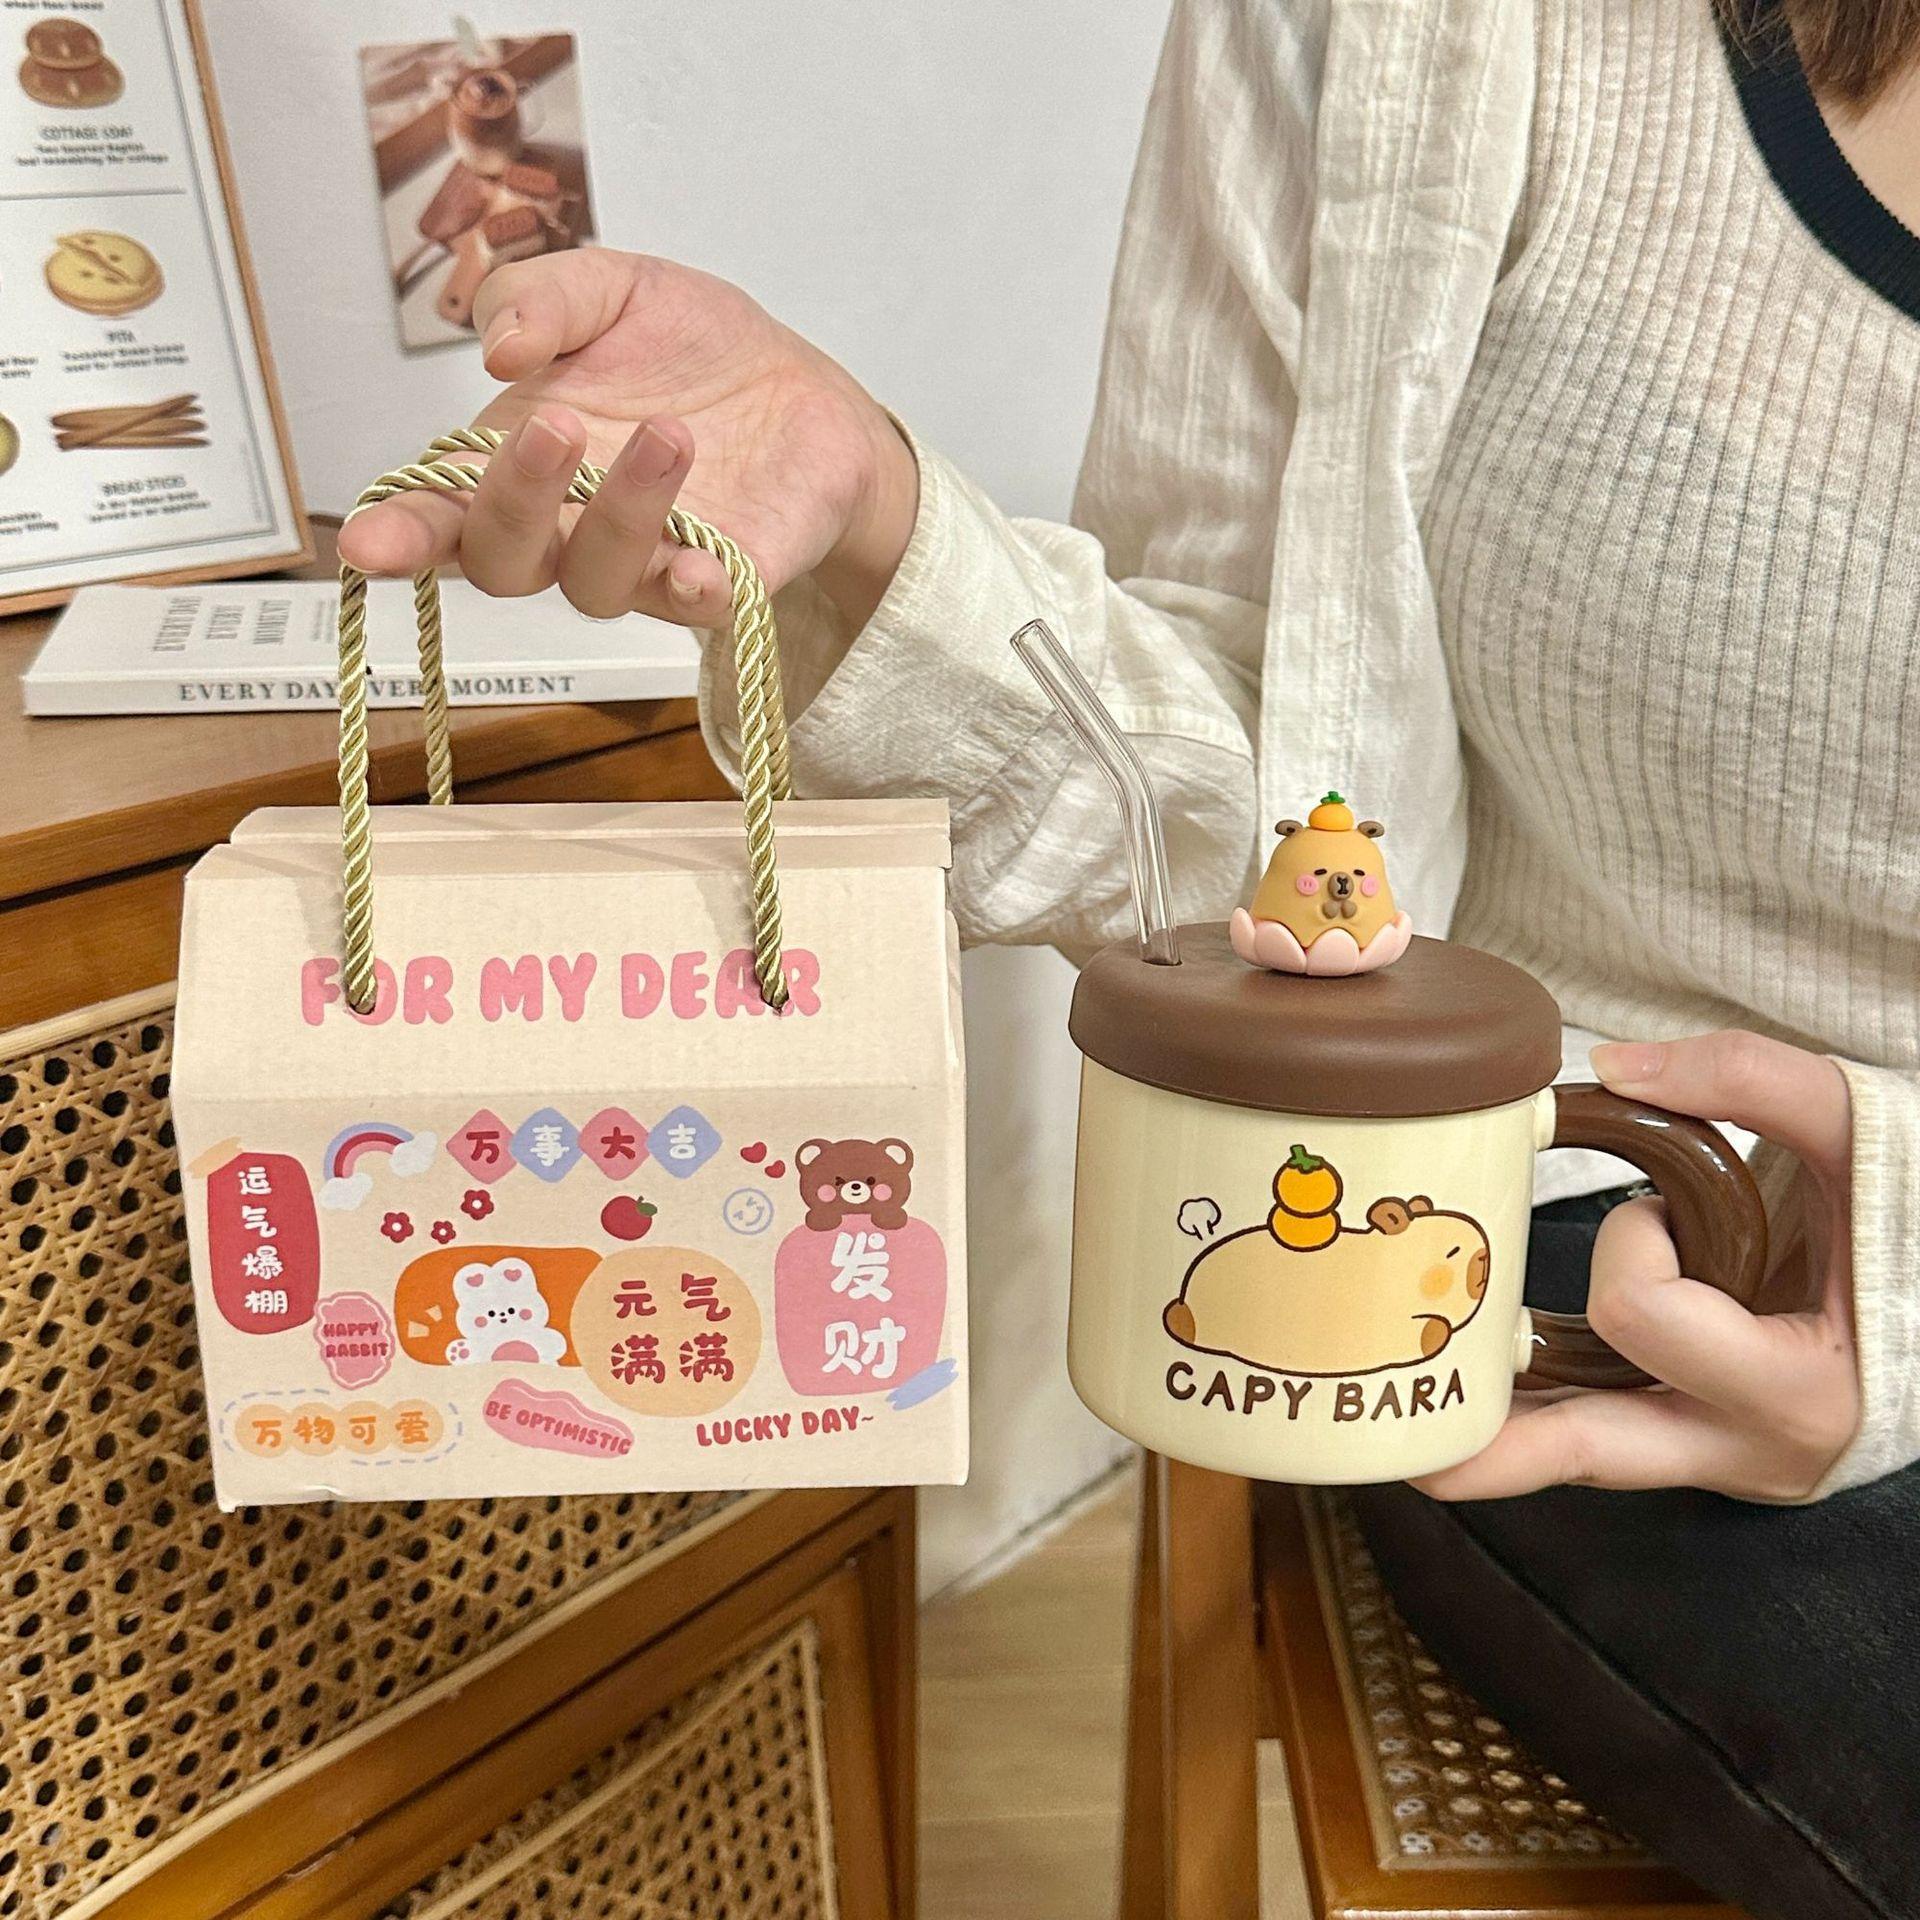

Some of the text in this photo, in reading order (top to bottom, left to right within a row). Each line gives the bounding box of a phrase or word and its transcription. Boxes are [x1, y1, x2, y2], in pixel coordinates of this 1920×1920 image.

[180, 682, 275, 701] EVERY
[287, 680, 340, 699] DAY
[453, 676, 575, 696] MOMENT
[301, 948, 821, 1026] FOR MY DEAR
[466, 1123, 696, 1167] 万事大吉
[238, 1166, 289, 1315] 运气爆棚
[613, 1273, 732, 1322] 元气
[822, 1231, 906, 1379] 发财
[323, 1322, 379, 1338] HAPPY
[325, 1342, 389, 1358] RABBIT
[610, 1332, 734, 1384] 满满
[1166, 1361, 1465, 1422] CAPY BARA
[252, 1410, 429, 1448] 万物可爱
[486, 1399, 632, 1456] BE OPTIMISTIC
[696, 1412, 791, 1447] LUCKY
